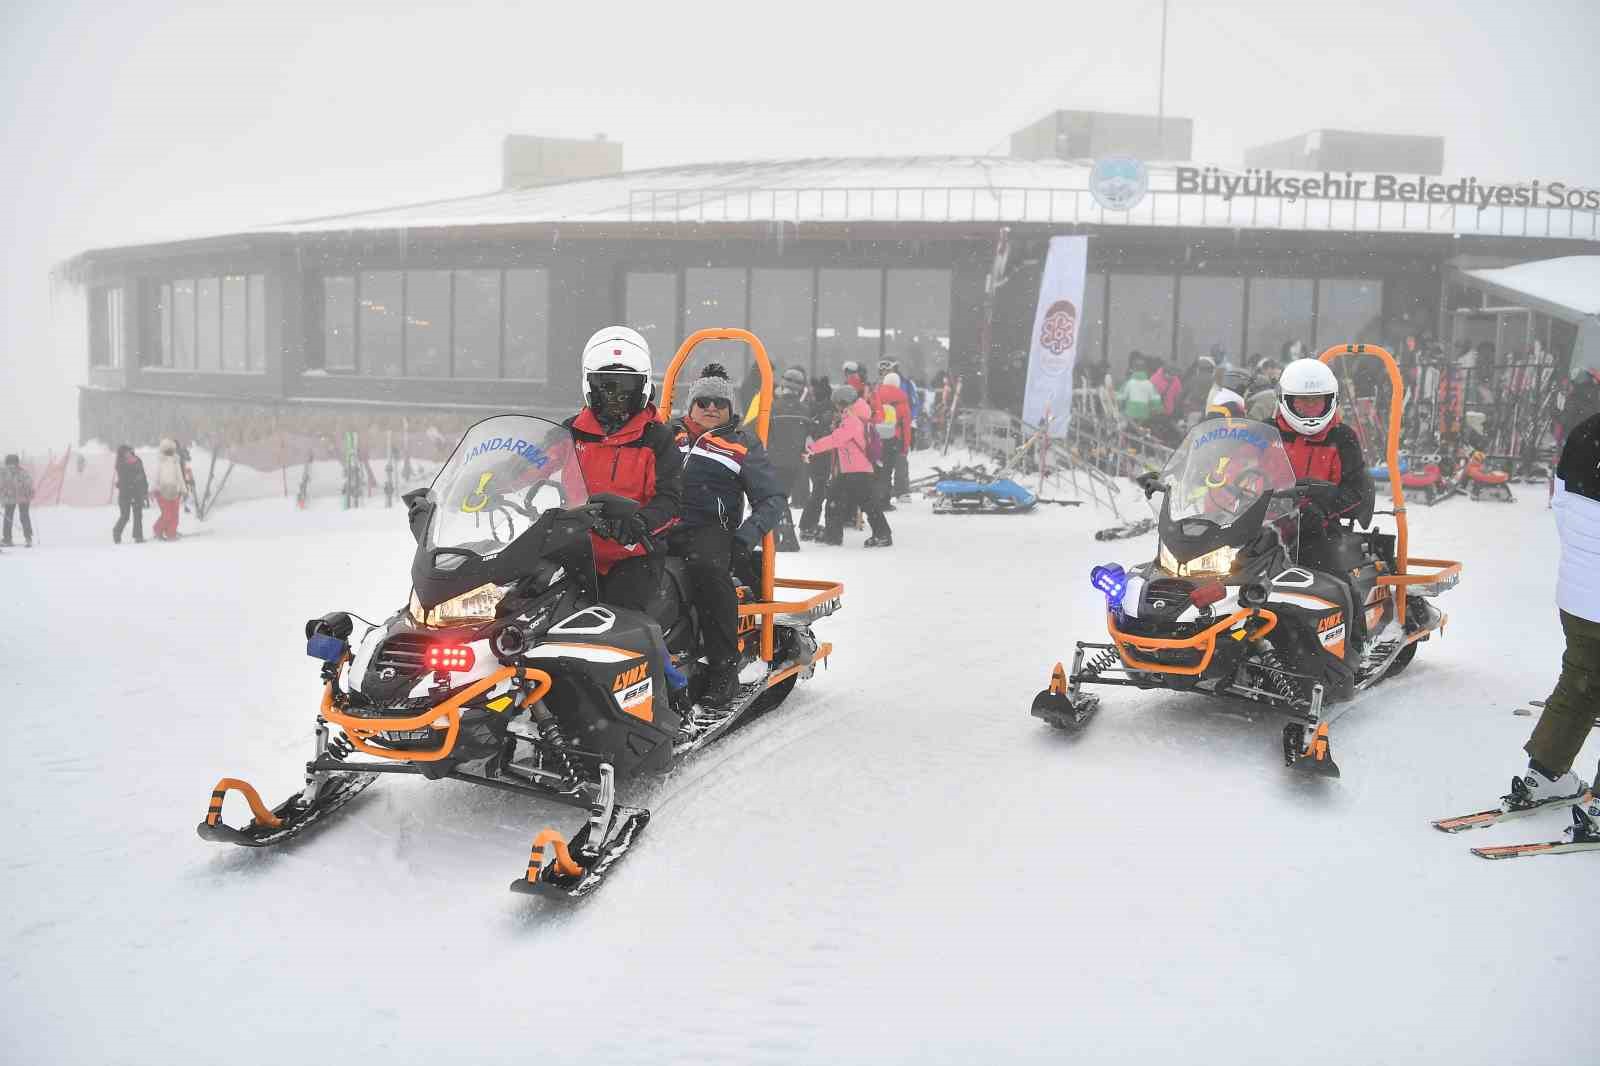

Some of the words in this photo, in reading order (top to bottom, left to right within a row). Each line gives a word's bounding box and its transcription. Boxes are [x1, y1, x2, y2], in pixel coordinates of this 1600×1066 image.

[1176, 167, 1367, 203] Büyükşehir
[1374, 174, 1539, 210] Belediyesi
[1546, 182, 1600, 208] Sos
[464, 437, 549, 469] JANDARMA
[1316, 610, 1344, 633] LYNX
[611, 661, 648, 692] LYNX
